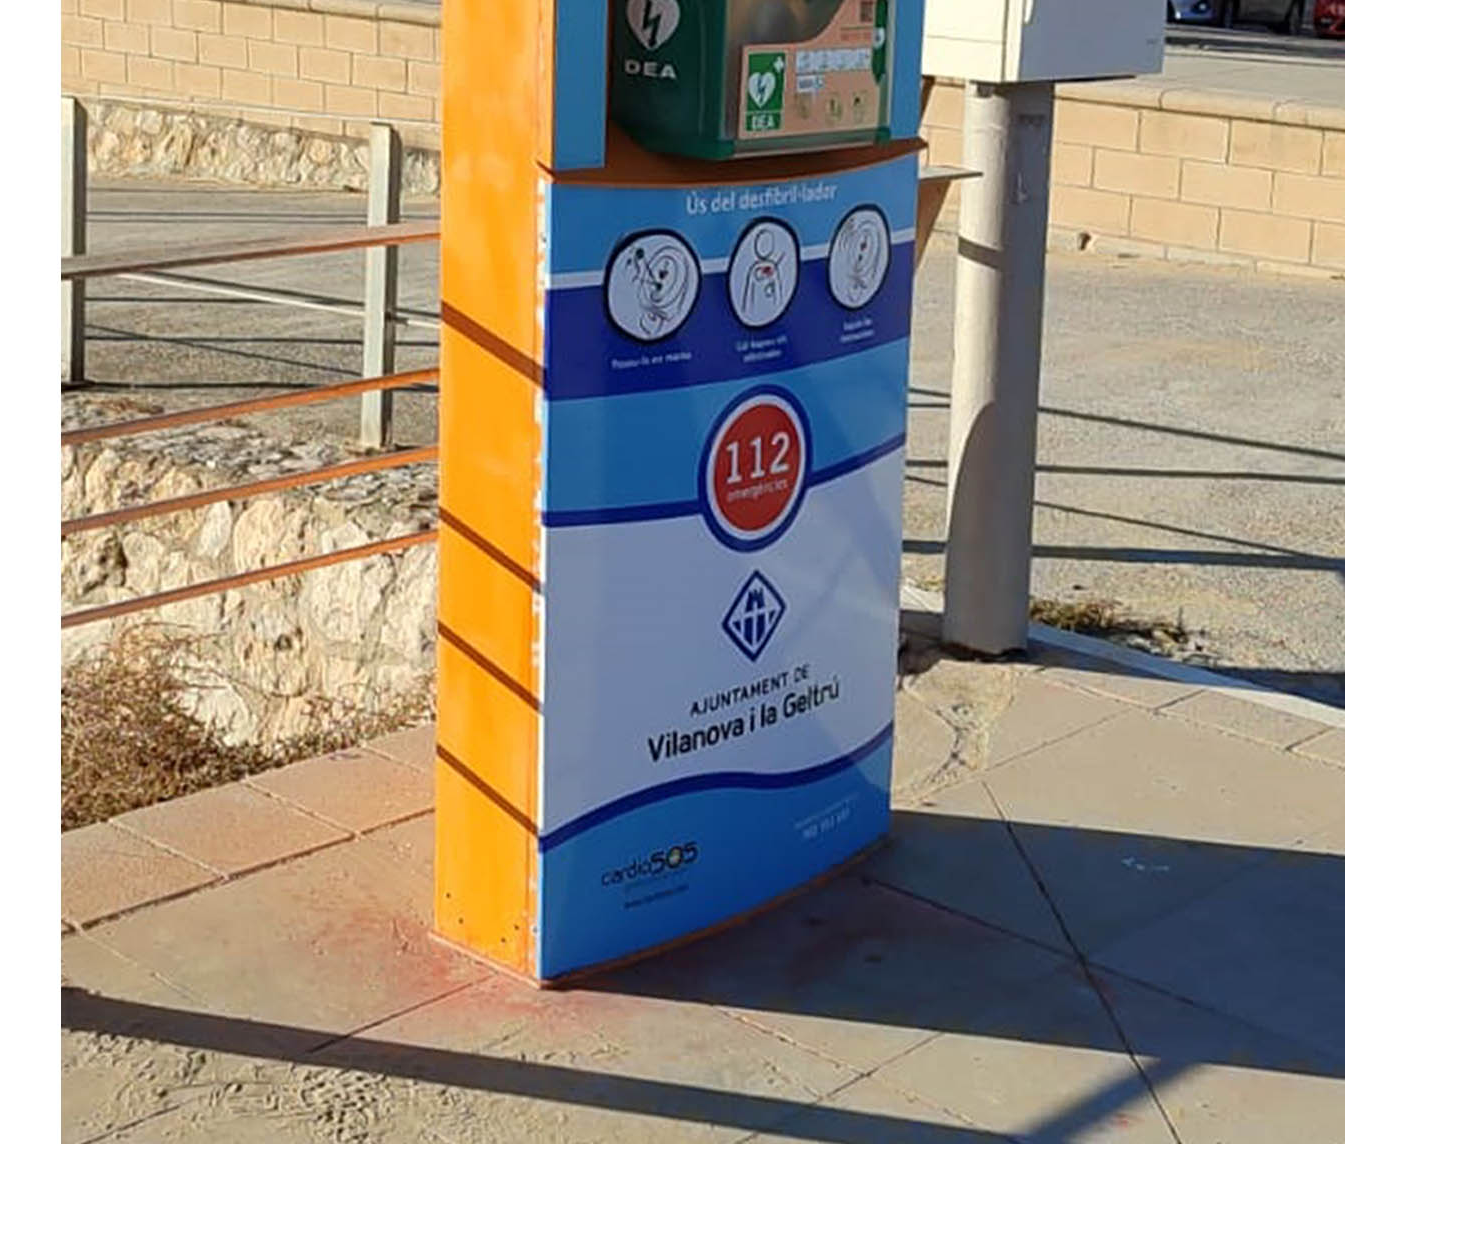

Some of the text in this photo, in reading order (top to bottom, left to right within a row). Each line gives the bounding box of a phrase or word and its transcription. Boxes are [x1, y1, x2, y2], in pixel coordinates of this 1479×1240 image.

[625, 60, 677, 79] DEA
[686, 190, 707, 215] Ús
[711, 191, 736, 212] del
[726, 431, 789, 484] 112
[690, 663, 810, 717] AJUNTAMENT DE
[648, 676, 840, 763] Vilanova i la Geltrú
